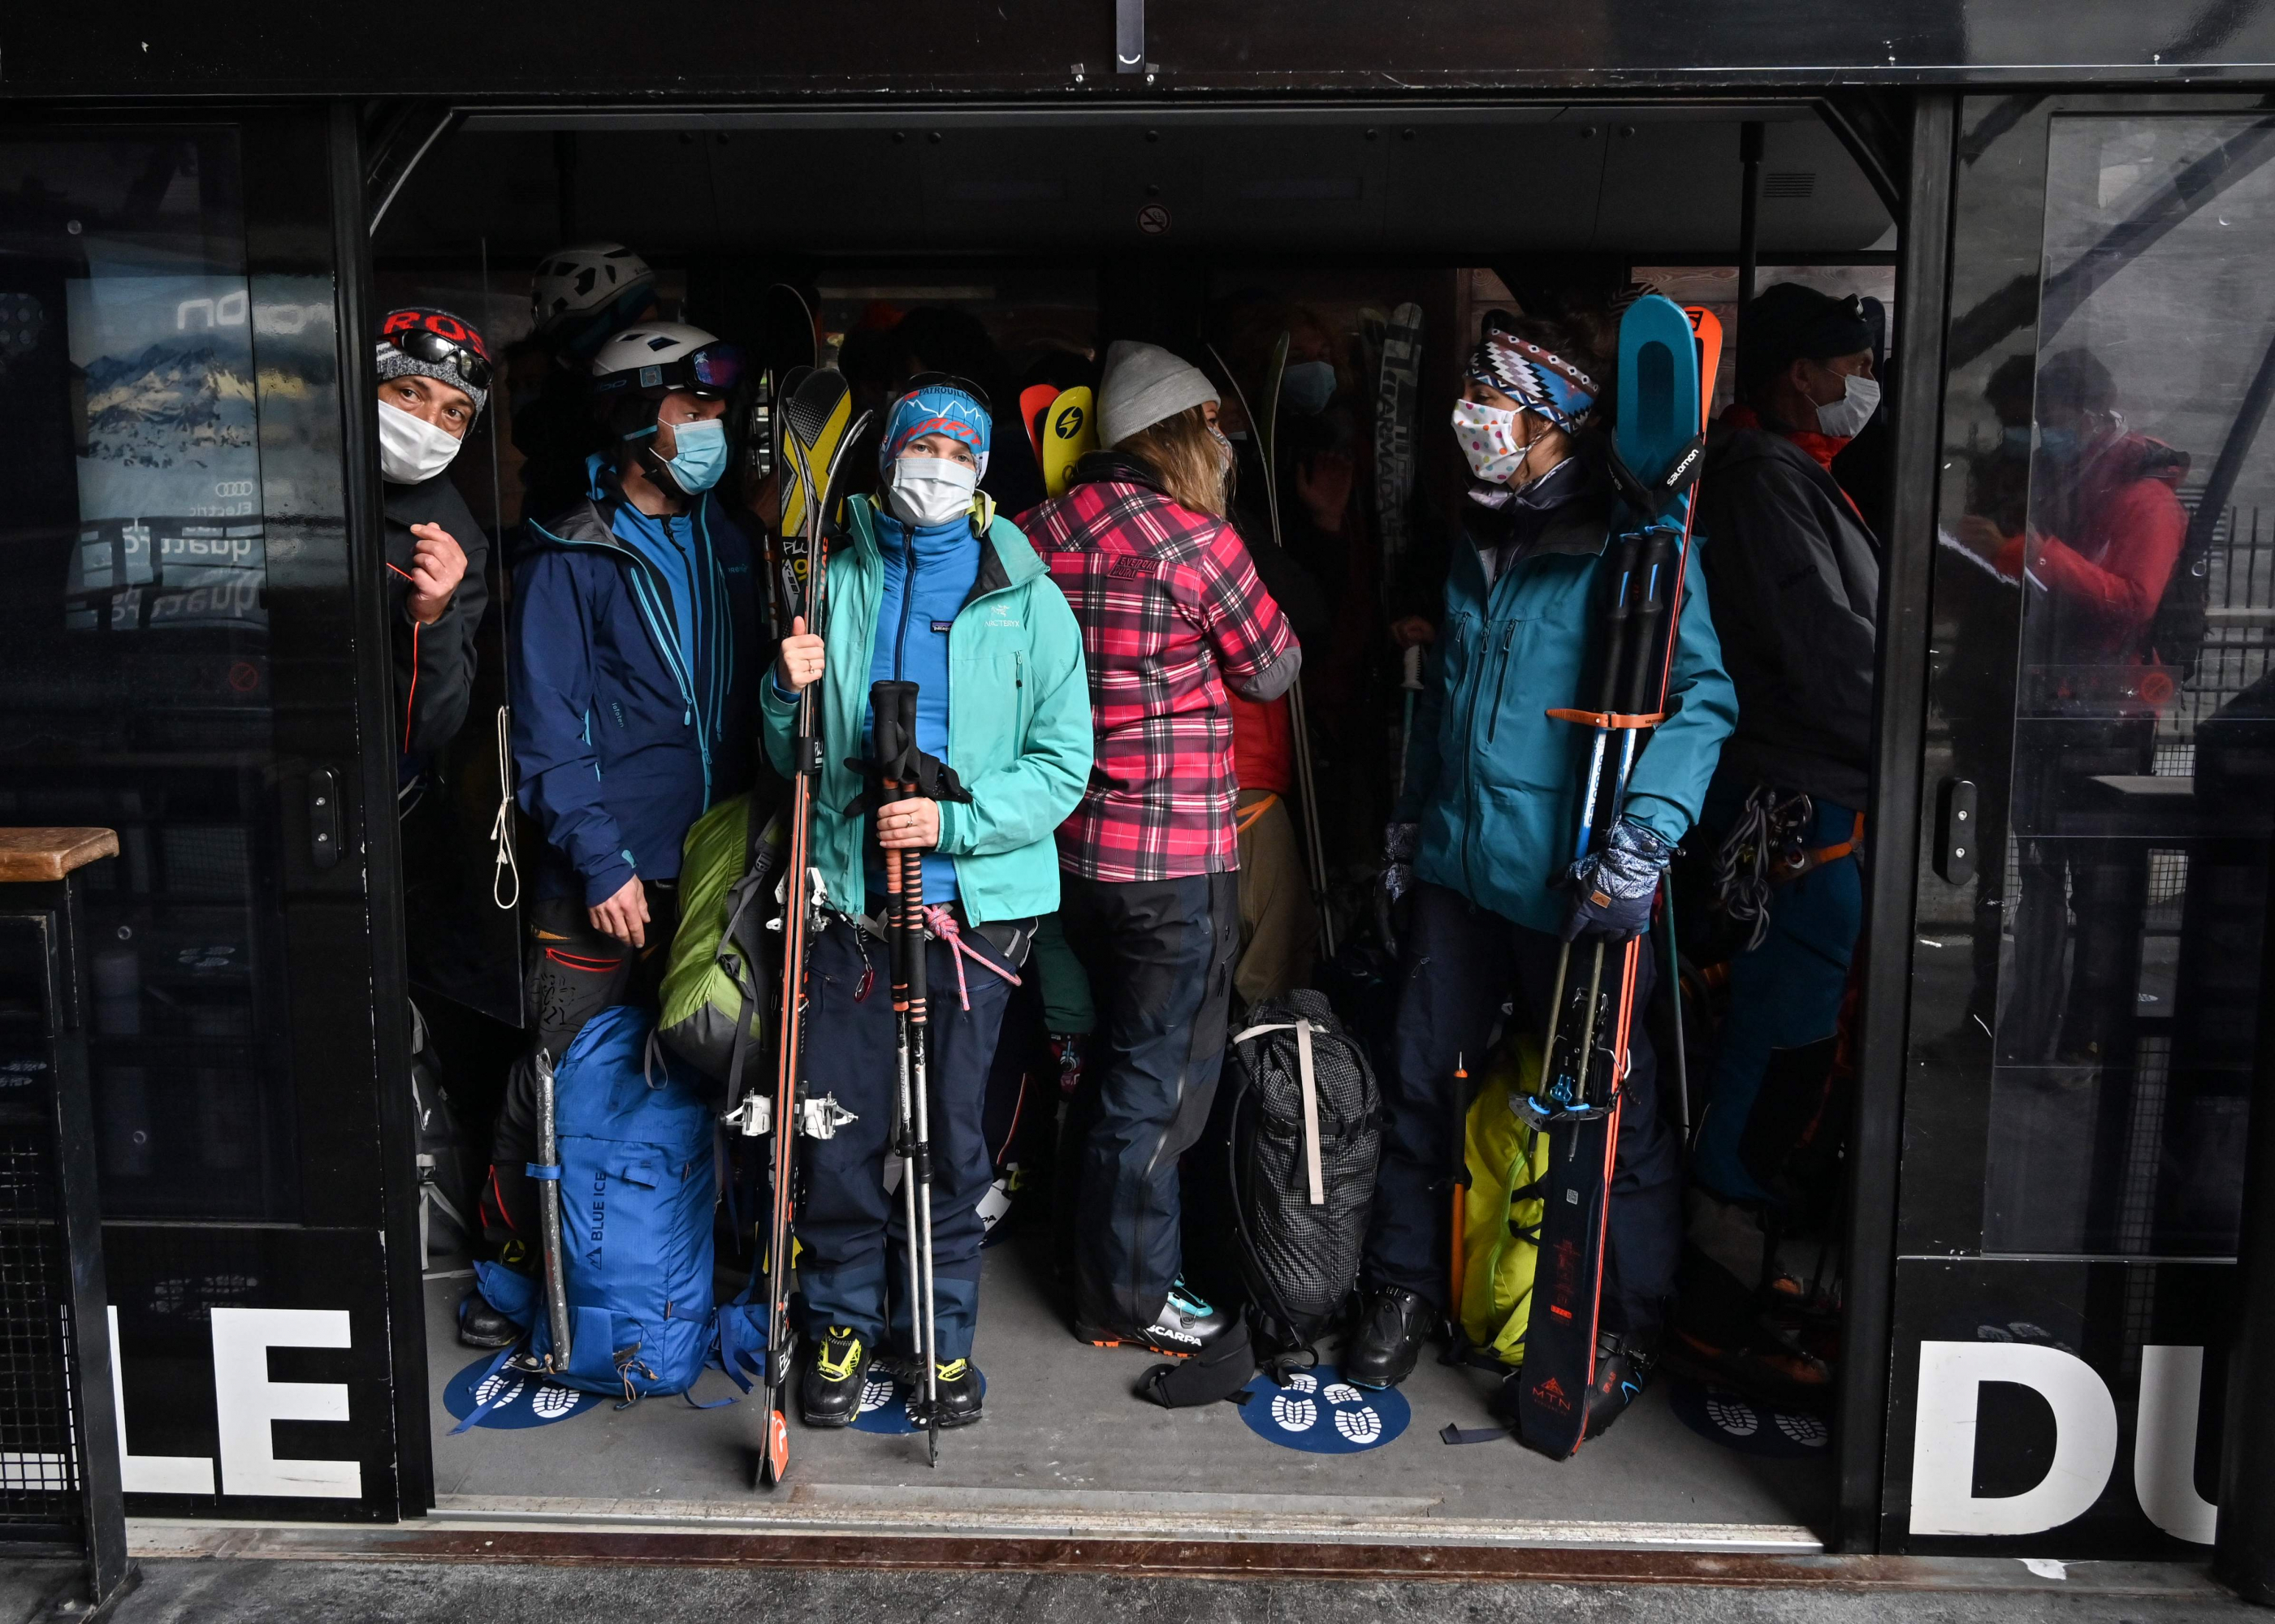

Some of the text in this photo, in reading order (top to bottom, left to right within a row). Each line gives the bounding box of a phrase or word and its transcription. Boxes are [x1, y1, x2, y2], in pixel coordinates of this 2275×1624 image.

[1667, 448, 1699, 487] salomon
[612, 702, 624, 728] lofoten
[590, 1172, 606, 1241] BLUE ICE
[1146, 1324, 1202, 1347] SCARPA
[1532, 1385, 1572, 1411] MTN
